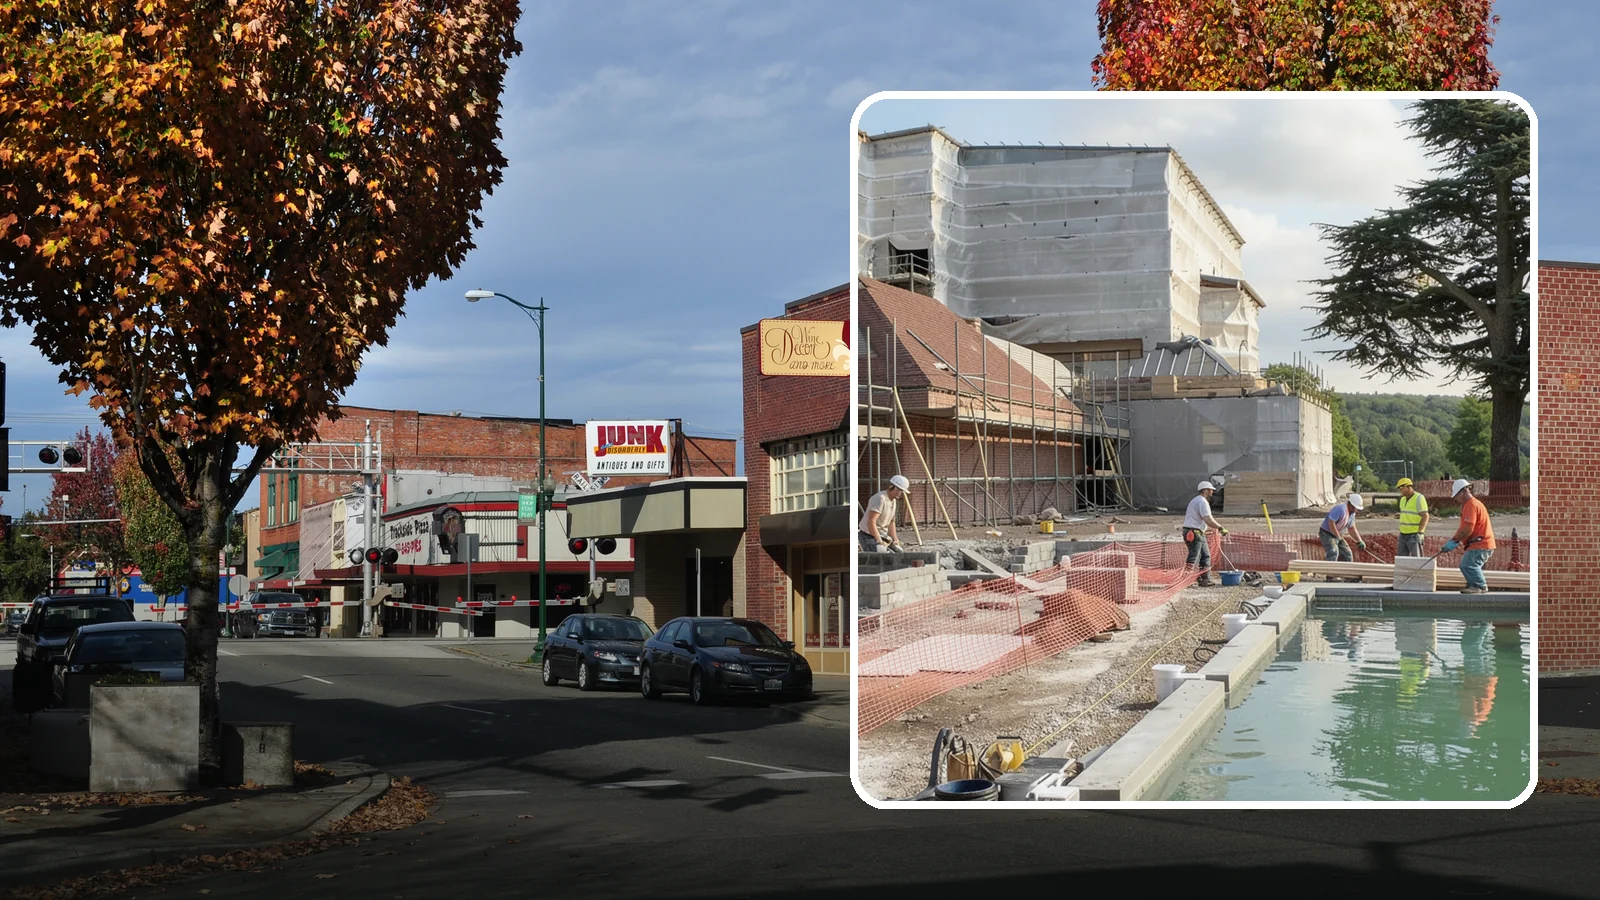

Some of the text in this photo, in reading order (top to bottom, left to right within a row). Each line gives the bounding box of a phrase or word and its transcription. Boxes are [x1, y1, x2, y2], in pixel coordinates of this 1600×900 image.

[596, 425, 665, 457] JUNK
[607, 445, 646, 454] DISORDERLY
[596, 460, 665, 470] ANTIQUES AND GIFTS
[414, 519, 429, 535] Pizza
